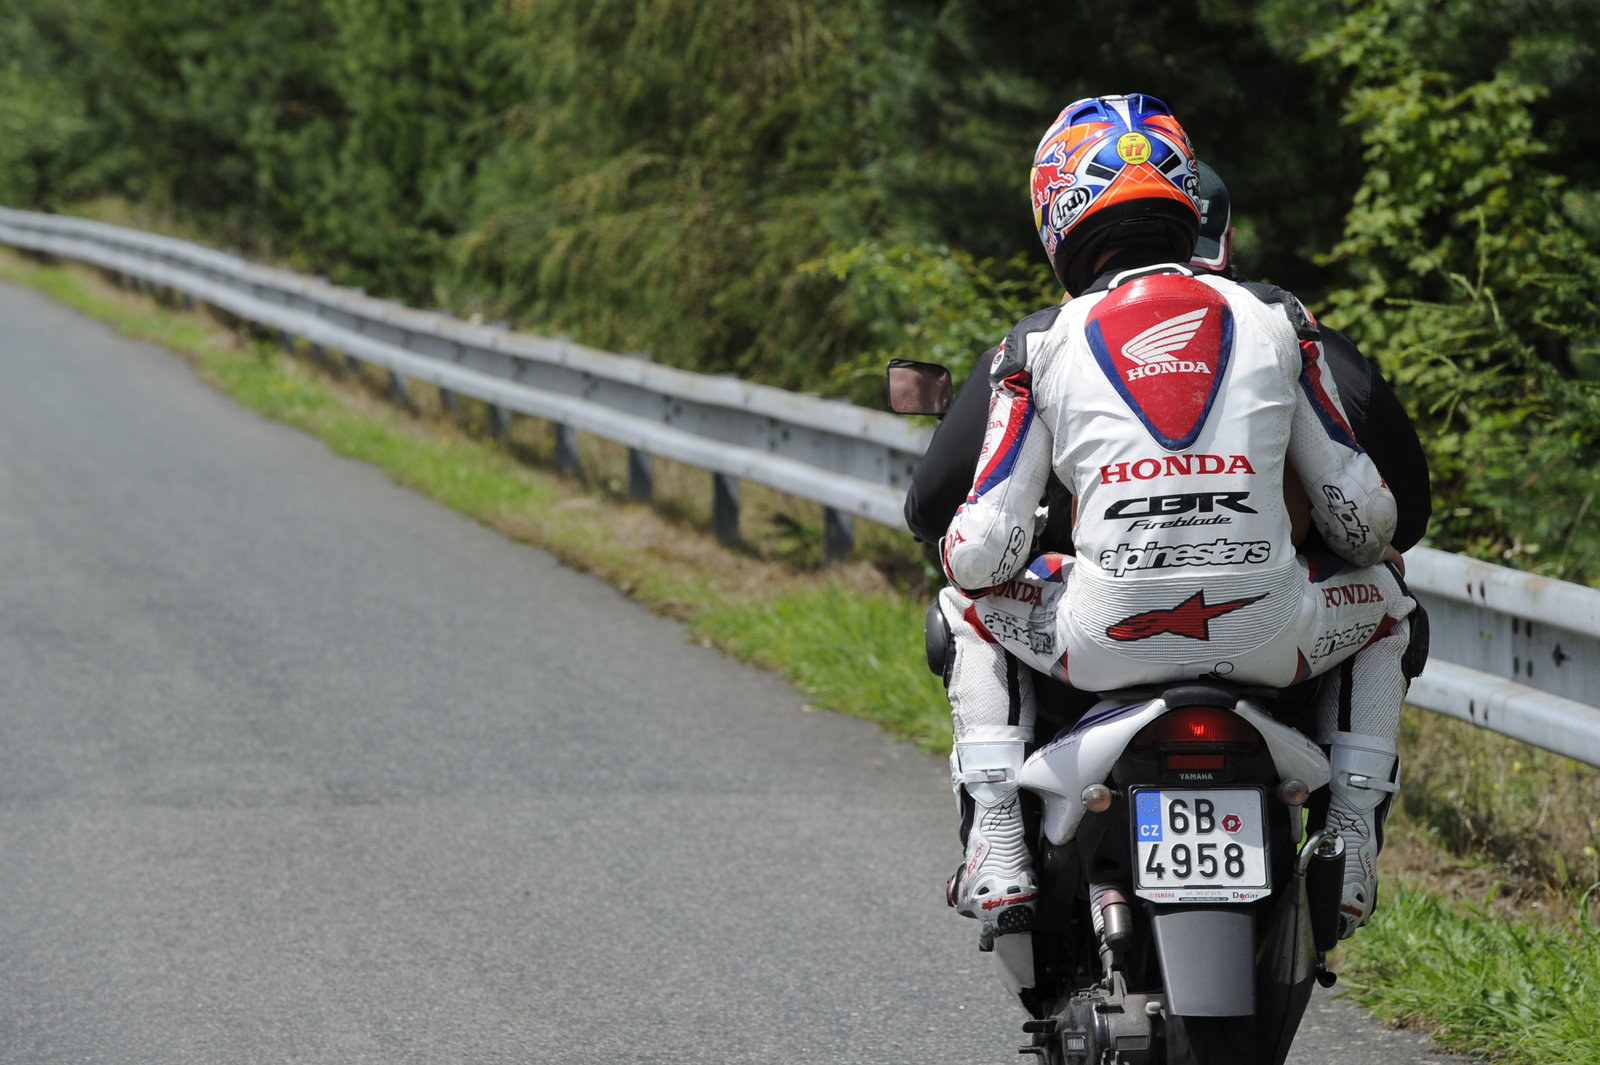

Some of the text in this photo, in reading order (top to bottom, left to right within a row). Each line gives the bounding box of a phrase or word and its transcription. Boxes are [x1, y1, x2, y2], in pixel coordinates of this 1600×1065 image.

[1126, 361, 1211, 382] HONDA
[1099, 454, 1256, 485] HONDA
[1103, 491, 1259, 520] CBR
[1126, 514, 1232, 533] Fireblade
[1099, 538, 1271, 578] alpinestars
[993, 580, 1043, 606] ONDA
[1322, 583, 1384, 608] HONDA
[1168, 798, 1216, 834] 6B
[1140, 825, 1159, 836] CZ
[1145, 843, 1245, 879] 4958
